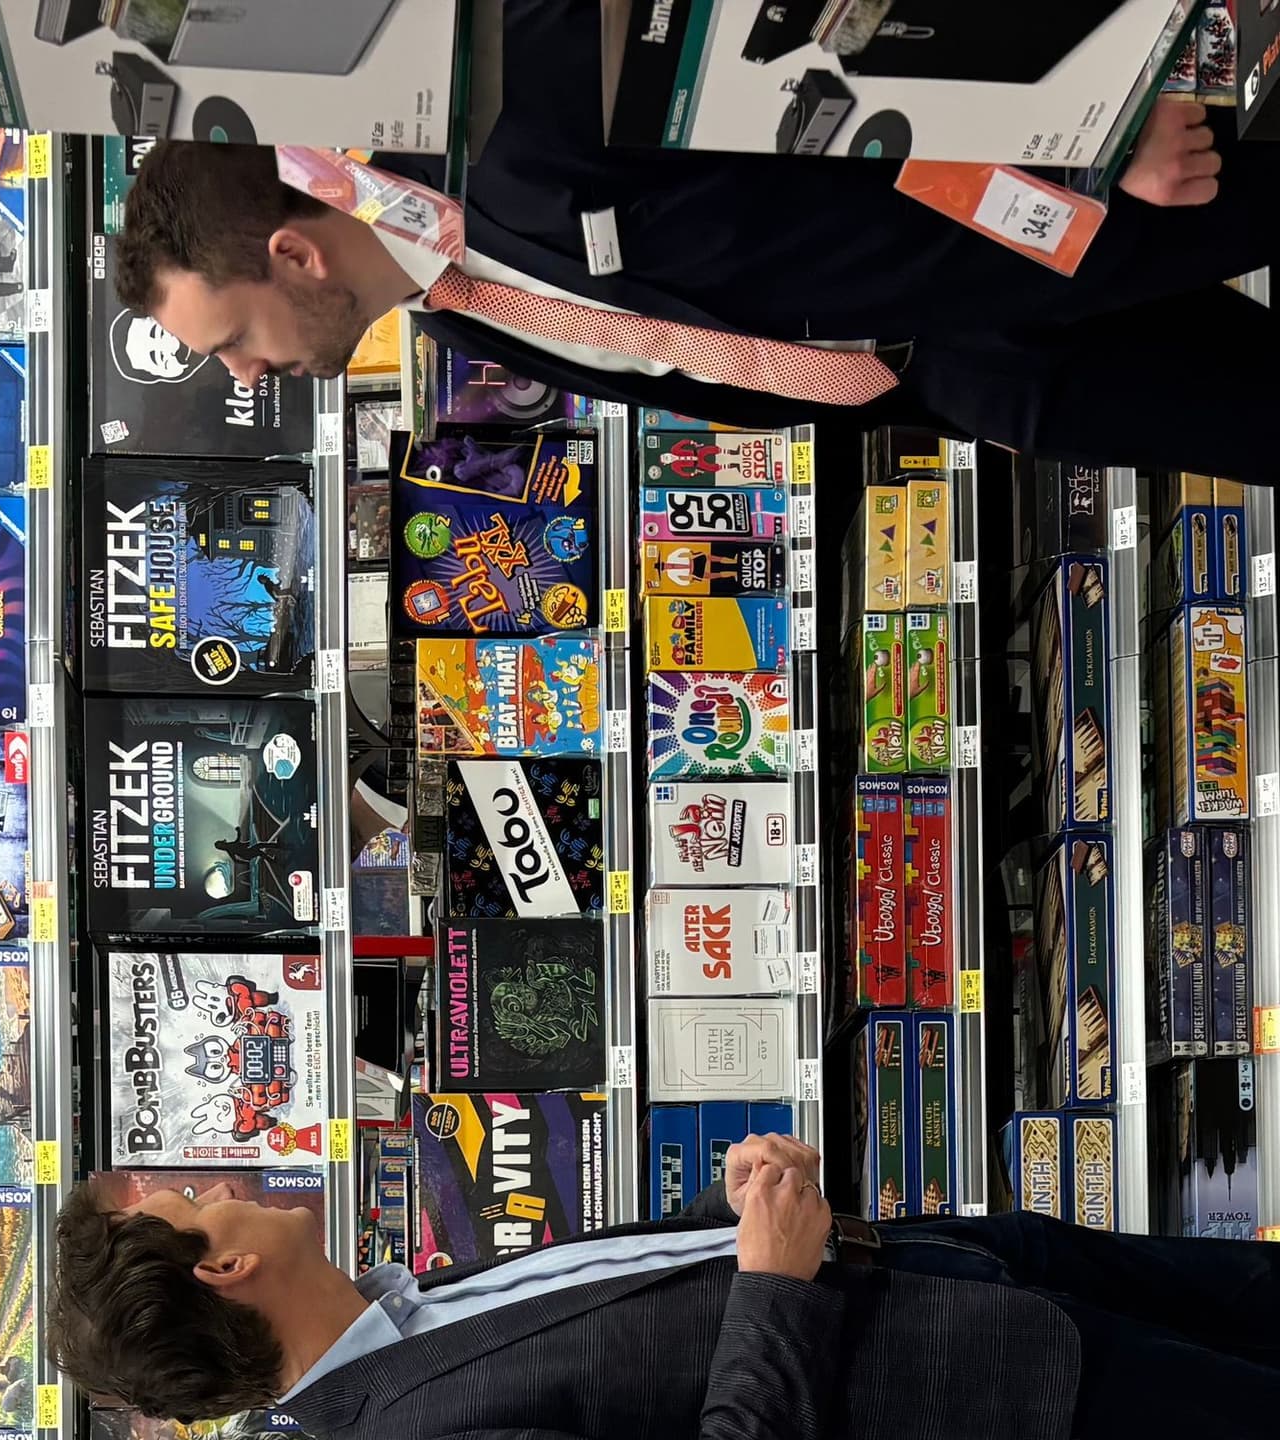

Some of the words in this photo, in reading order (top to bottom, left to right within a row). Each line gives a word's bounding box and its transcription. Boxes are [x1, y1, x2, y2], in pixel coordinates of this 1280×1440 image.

[1022, 204, 1054, 239] 34.99
[259, 374, 268, 396] DAS
[742, 442, 753, 479] QUICK
[753, 440, 766, 479] STOP
[480, 512, 530, 577] XXL
[106, 501, 147, 648] FITZEK
[149, 501, 176, 648] SAFEHOUSE
[742, 551, 753, 588] QUICK
[753, 549, 766, 589] STOP
[90, 570, 105, 648] SEBASTIAN
[684, 600, 696, 666] FAMILY
[495, 646, 518, 700] THAT!
[496, 703, 518, 748] BEAT
[12, 754, 23, 779] noris
[109, 740, 149, 888] FITZEK
[152, 741, 176, 888] UNDERGROUND
[669, 803, 702, 839] Ja
[700, 793, 729, 860] Nein
[732, 801, 745, 845] JUGENDFREI
[770, 820, 781, 841] 18+
[93, 810, 108, 888] SEBASTIAN
[492, 788, 550, 903] Tabu
[729, 847, 740, 866] NICHT
[879, 834, 894, 882] Classic
[684, 905, 700, 952] ALTER
[873, 885, 896, 942] Ubongo!
[702, 904, 731, 979] SACK
[305, 1012, 313, 1030] Team
[448, 928, 470, 1078] ULTRAVIOLETT
[246, 1041, 263, 1078] 00:02
[305, 1032, 313, 1052] beste
[305, 1054, 313, 1067] das
[708, 1028, 718, 1071] TRUTH
[724, 1029, 735, 1071] DRINK
[305, 1069, 313, 1094] wollten
[582, 1119, 591, 1161] WISSEN
[594, 1112, 602, 1150] LOCH?
[881, 1102, 890, 1145] SCHACH-
[888, 1099, 897, 1146] KASSETTE
[492, 1100, 545, 1255] RAVITY
[583, 1163, 591, 1189] DEIN
[595, 1151, 603, 1221] SCHWARZEN
[1207, 1212, 1250, 1222] TOWER
